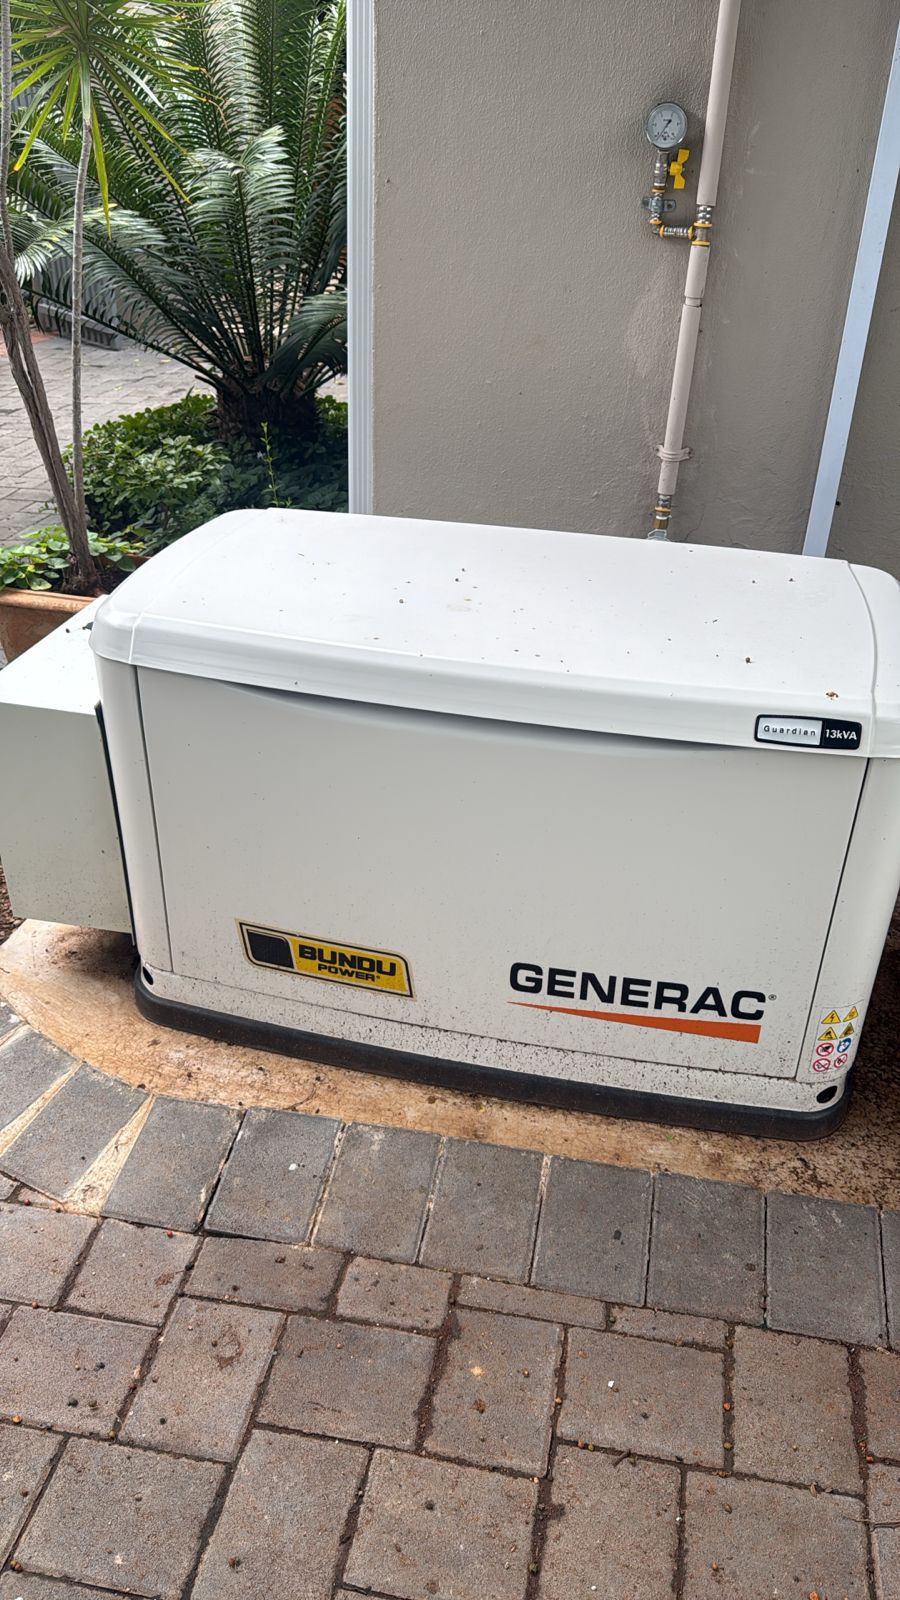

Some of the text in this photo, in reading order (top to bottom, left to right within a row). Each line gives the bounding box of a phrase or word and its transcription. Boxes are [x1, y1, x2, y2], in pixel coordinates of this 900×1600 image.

[763, 724, 858, 740] Guardian 13kVA
[298, 943, 397, 977] BUNDU
[317, 963, 376, 982] POWER
